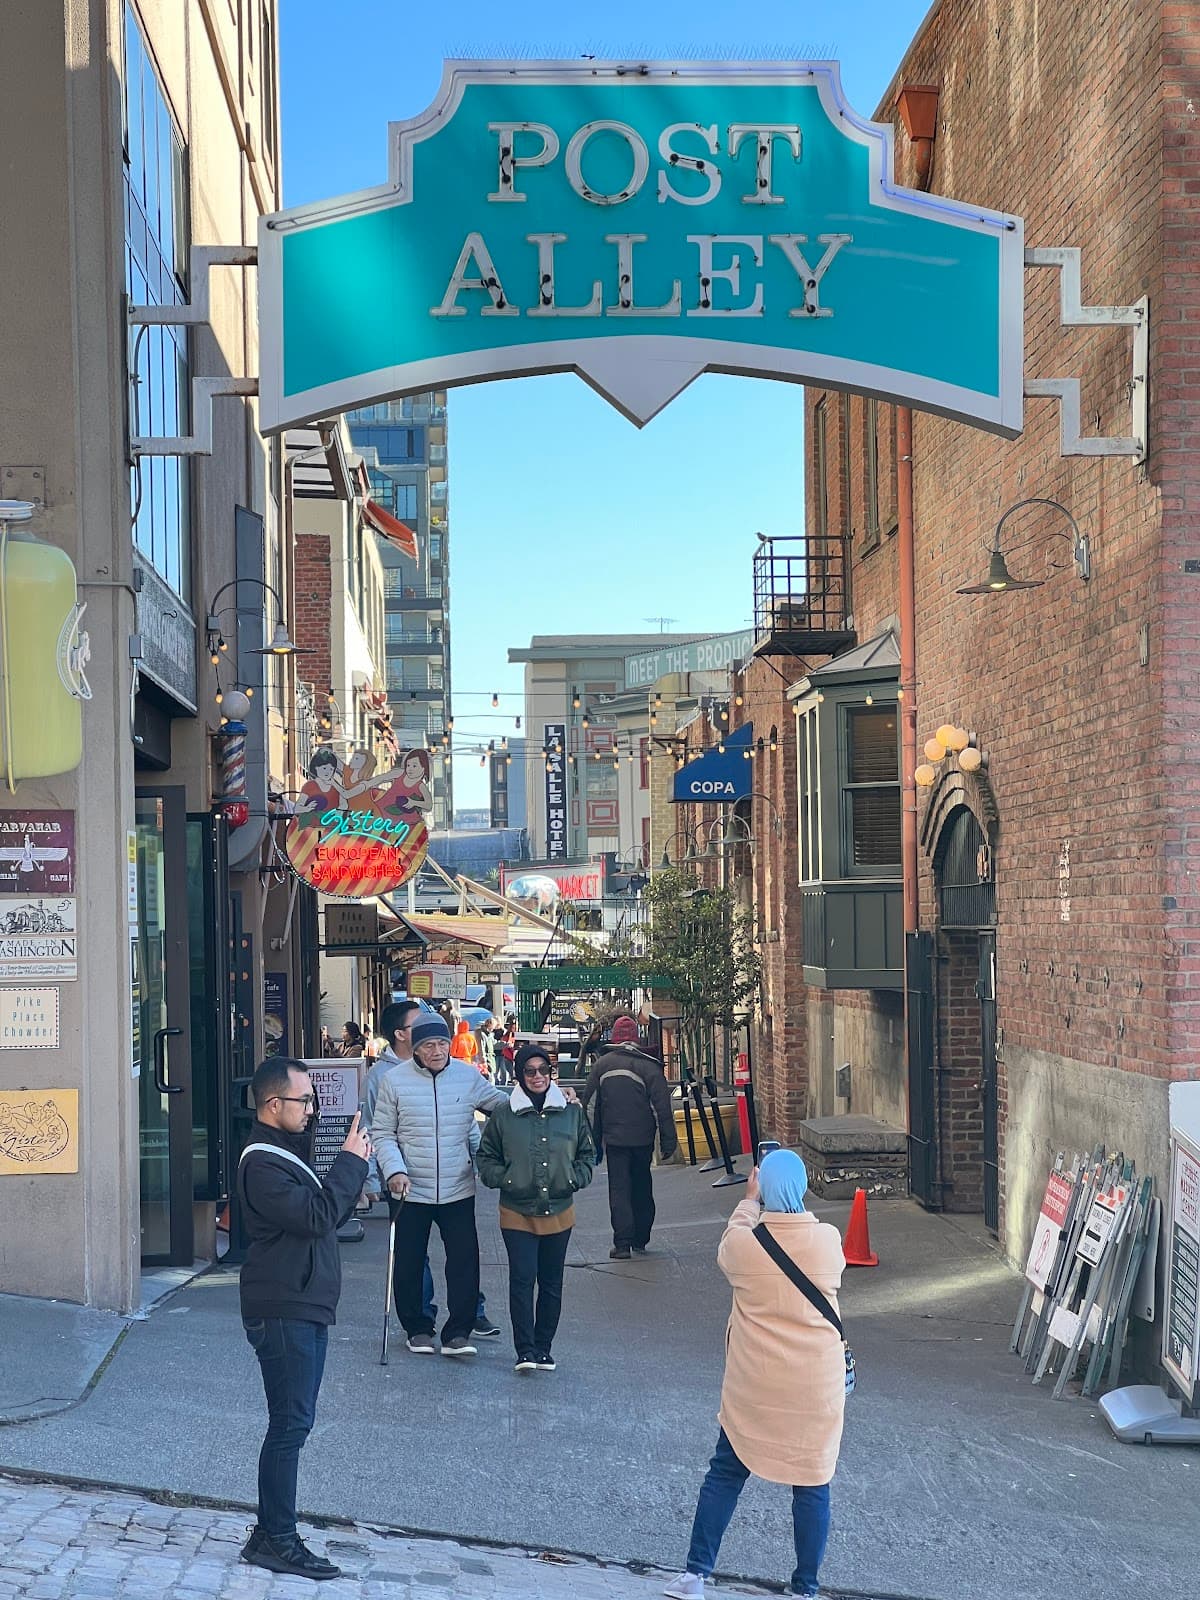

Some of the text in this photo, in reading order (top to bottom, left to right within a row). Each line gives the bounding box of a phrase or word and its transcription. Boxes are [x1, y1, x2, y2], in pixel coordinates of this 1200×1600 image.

[487, 119, 801, 206] POST
[429, 231, 854, 318] ALLEY
[629, 634, 755, 683] MEET THE PRODUC
[690, 781, 735, 794] COPA
[0, 822, 62, 833] ARVAHAR
[317, 847, 400, 861] EUROPEAN
[311, 864, 403, 881] SANDWICHES
[16, 996, 41, 1007] Pike
[12, 1011, 44, 1022] Place
[4, 1026, 52, 1037] Chowder
